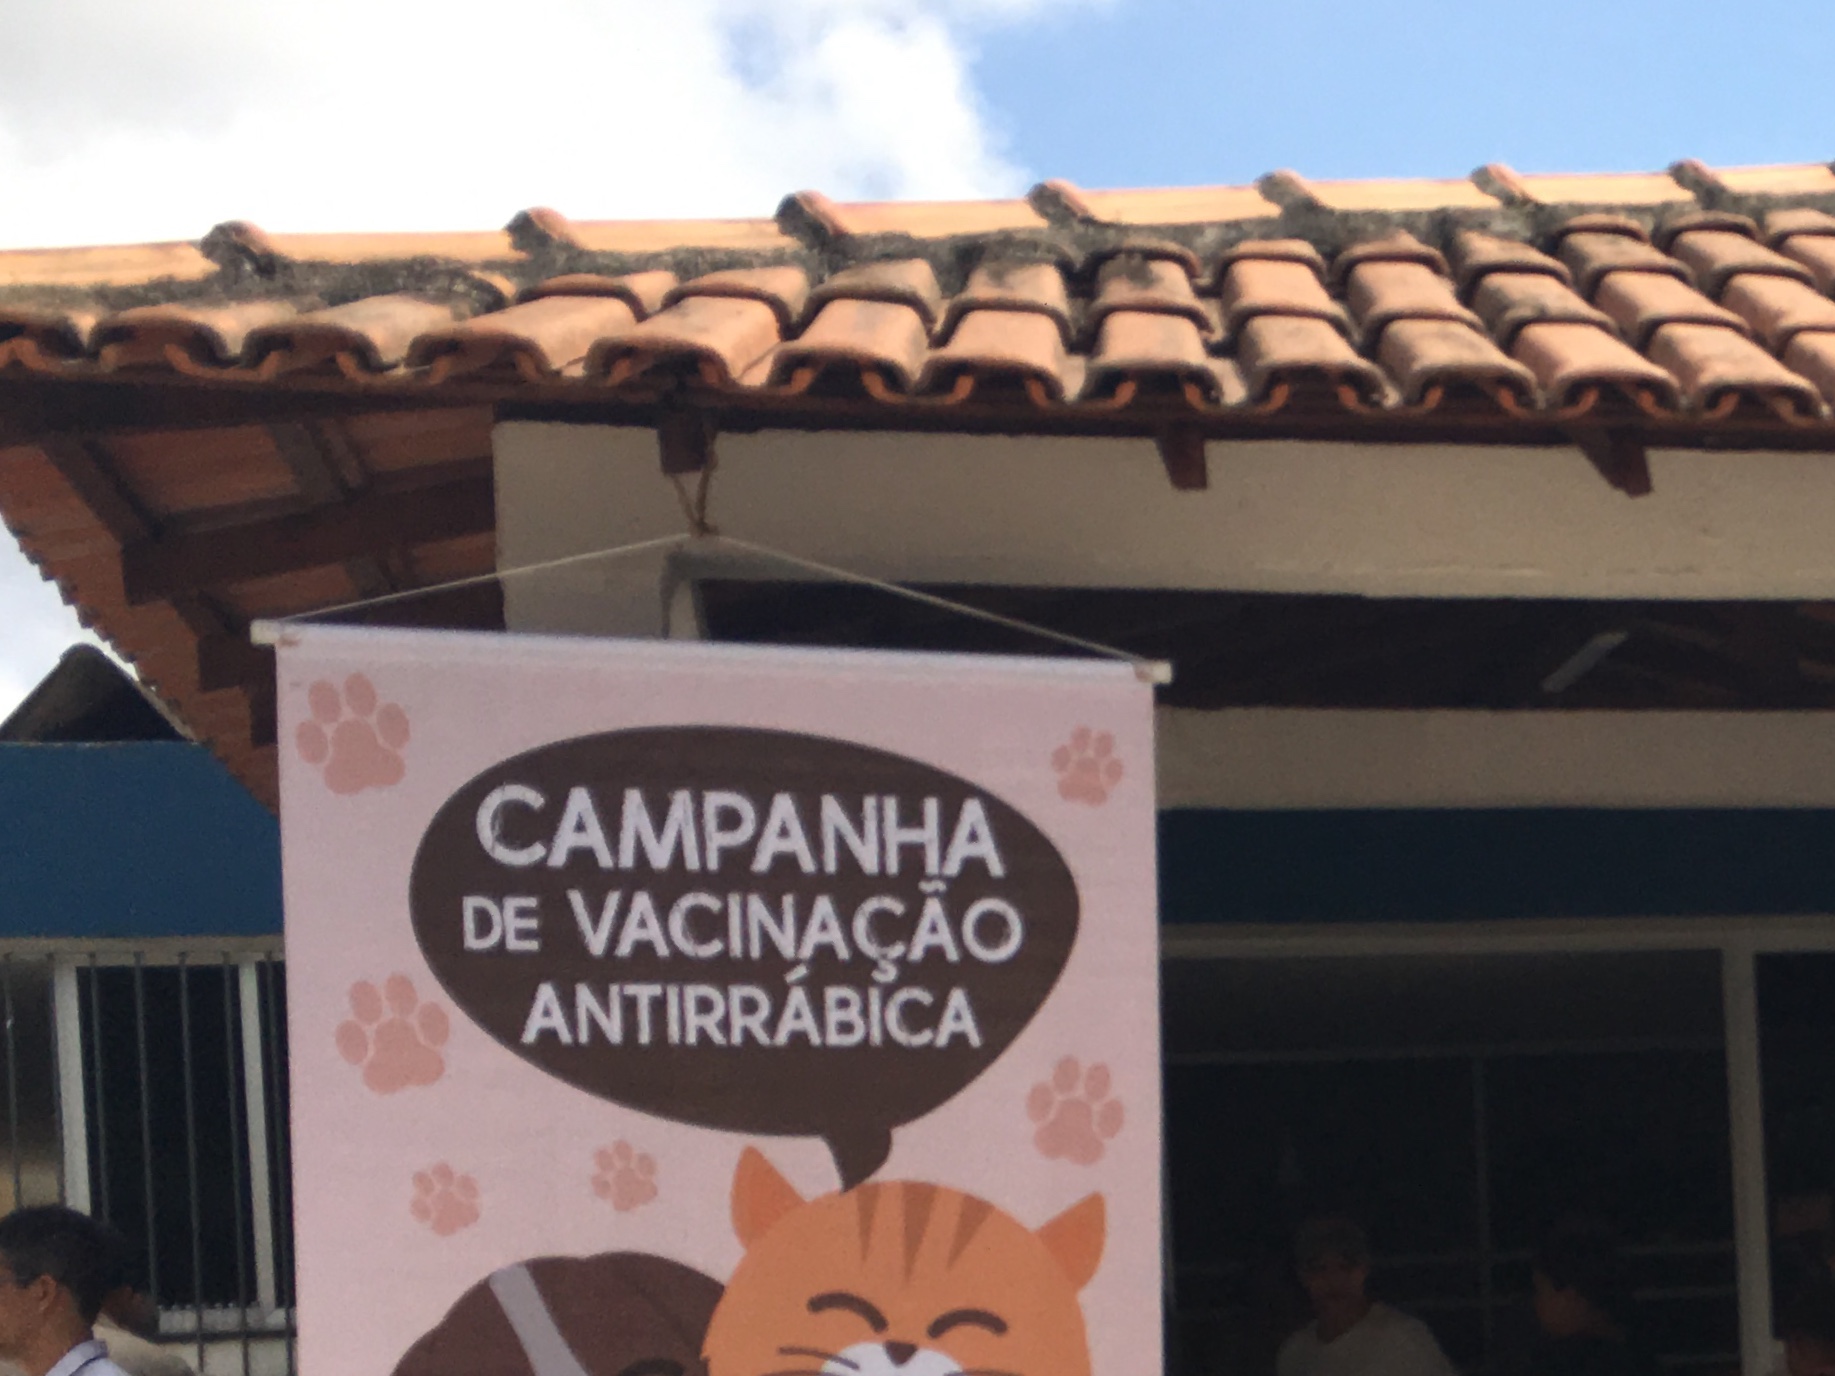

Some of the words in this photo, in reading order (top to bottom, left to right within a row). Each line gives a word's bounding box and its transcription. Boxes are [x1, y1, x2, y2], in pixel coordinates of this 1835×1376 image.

[475, 784, 1005, 877] CAMPANHA
[462, 896, 540, 952] DE
[568, 880, 1024, 984] VACINAÇÃO
[521, 965, 982, 1048] ANTIRRÁBICA
